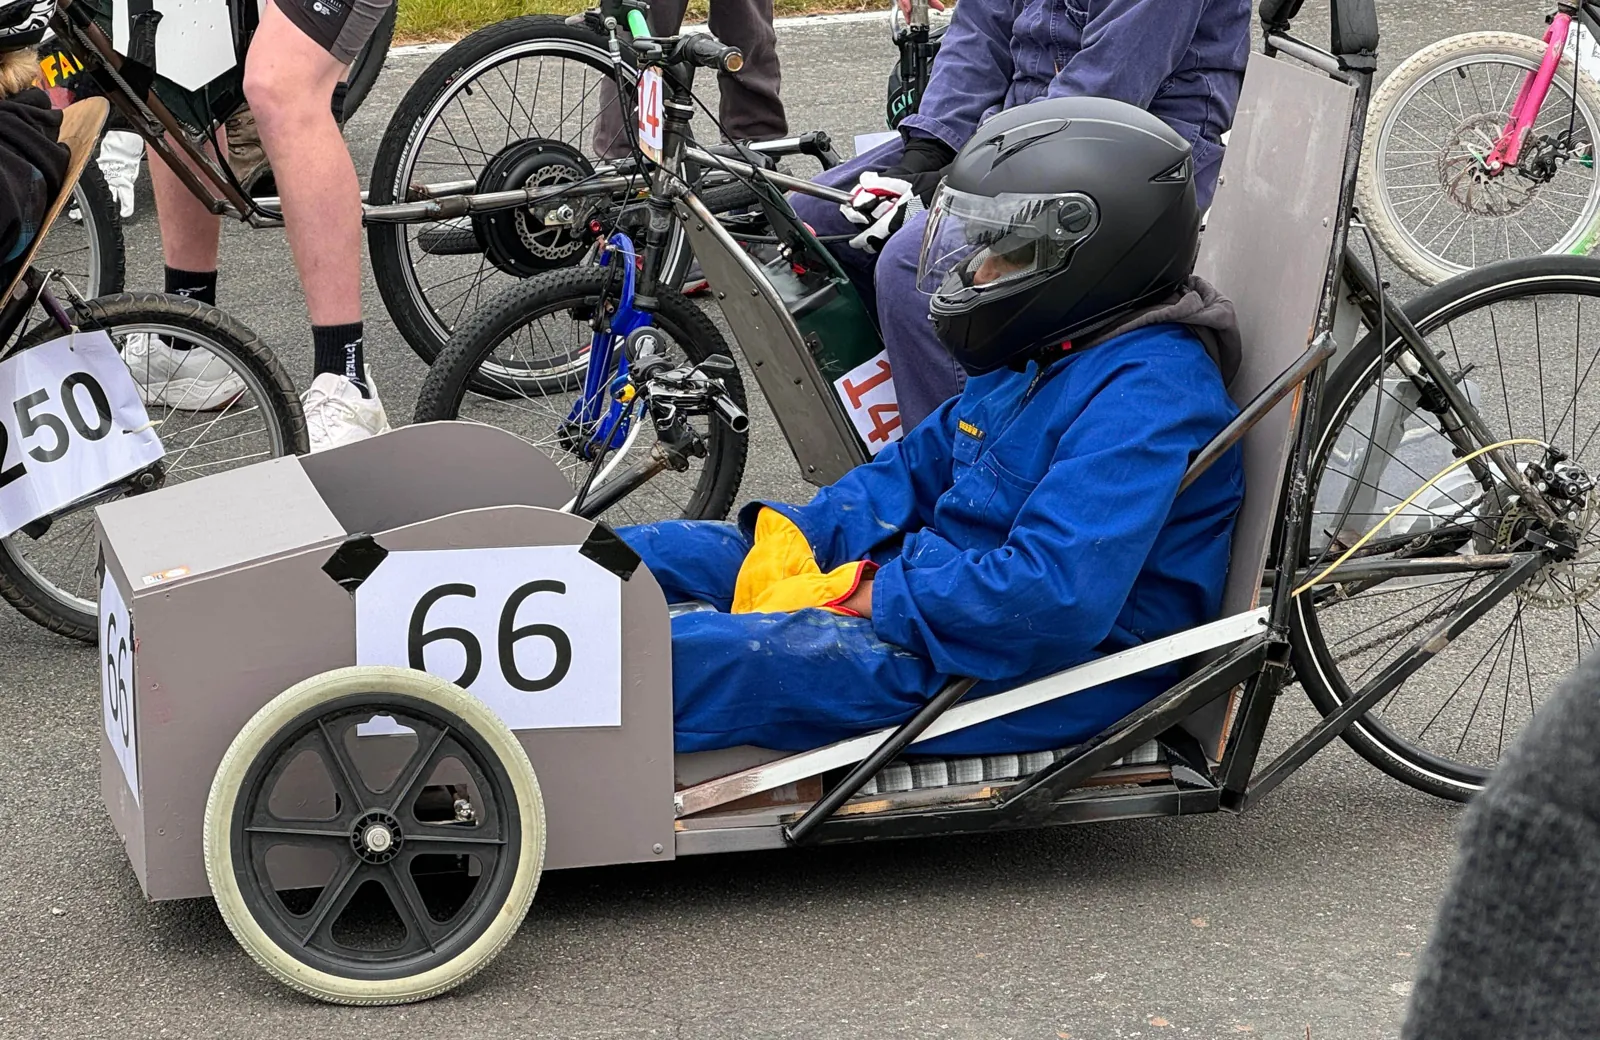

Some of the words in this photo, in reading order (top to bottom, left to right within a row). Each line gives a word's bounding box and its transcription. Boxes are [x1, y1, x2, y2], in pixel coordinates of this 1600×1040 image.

[636, 74, 660, 139] 14
[842, 359, 902, 443] 14
[107, 612, 129, 749] 66
[407, 579, 573, 692] 66
